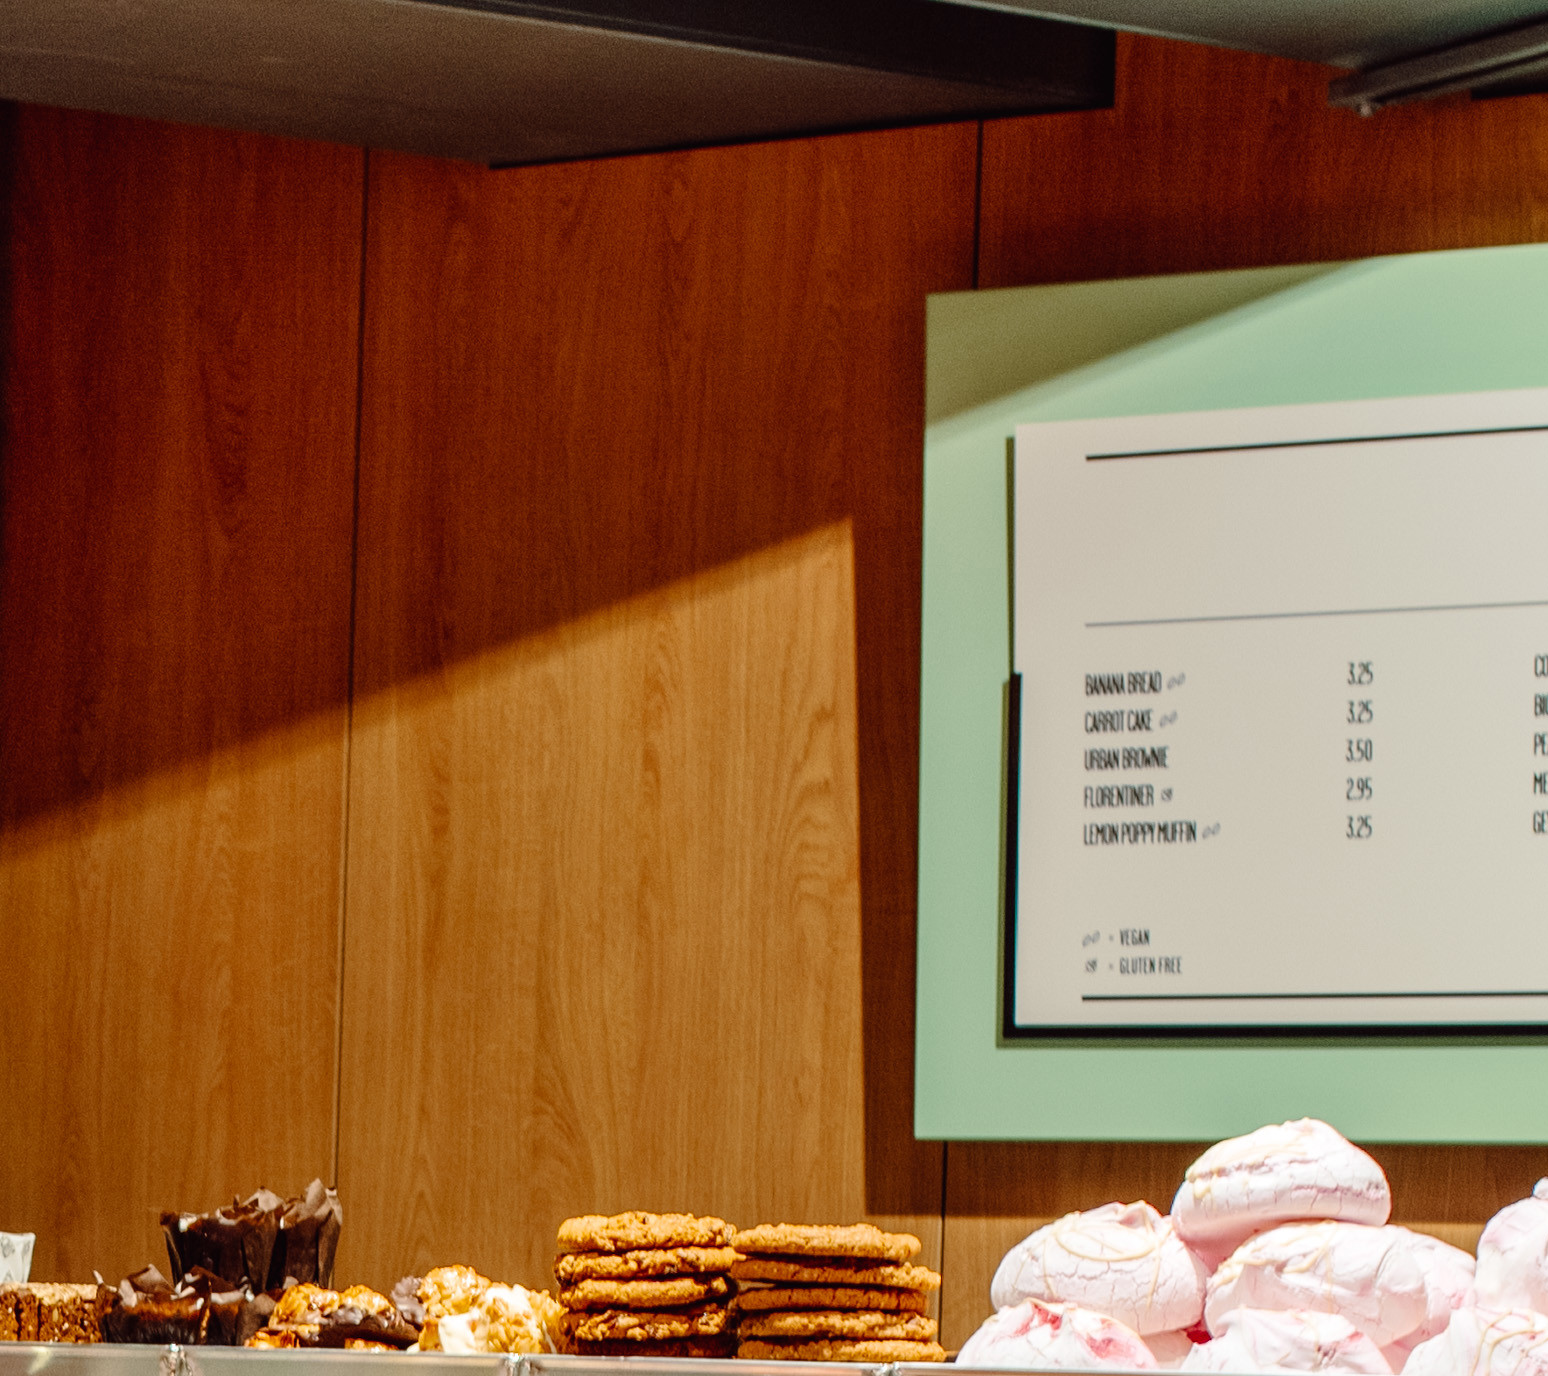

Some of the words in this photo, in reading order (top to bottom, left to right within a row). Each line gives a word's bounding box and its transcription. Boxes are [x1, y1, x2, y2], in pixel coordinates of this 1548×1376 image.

[1085, 673, 1125, 695] BANANA
[1128, 671, 1162, 693] BREAD
[1348, 661, 1373, 684] 3.25
[1085, 710, 1124, 733] CARROT
[1128, 709, 1152, 731] CAKE
[1348, 701, 1373, 723] 3.25
[1085, 749, 1119, 770] URBAN
[1123, 746, 1168, 769] BROWNIE
[1346, 739, 1372, 762] 3.50
[1084, 784, 1154, 808] FLORENTINER
[1347, 778, 1372, 800] 2.95
[1084, 823, 1118, 845] LEMON
[1122, 822, 1154, 844] POPPY
[1158, 821, 1196, 843] MUFFIN
[1347, 816, 1372, 838] 3.25
